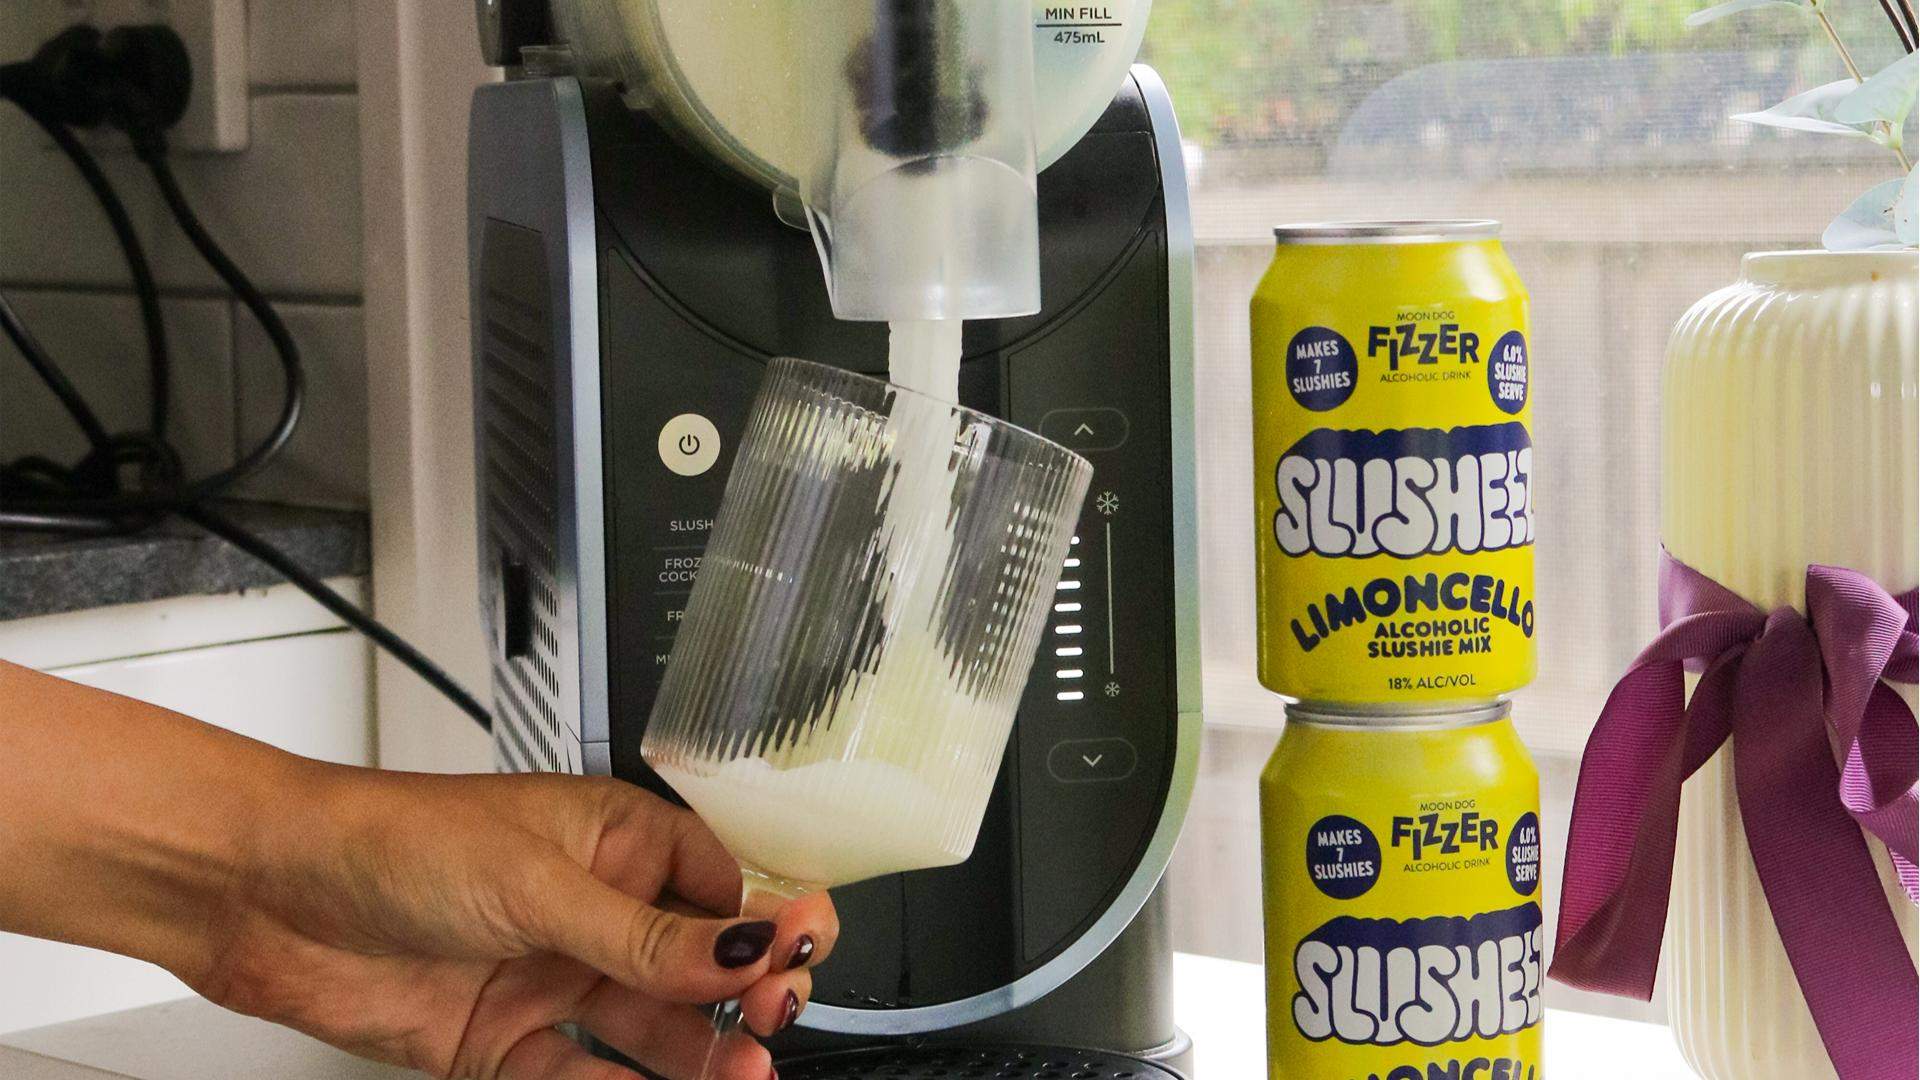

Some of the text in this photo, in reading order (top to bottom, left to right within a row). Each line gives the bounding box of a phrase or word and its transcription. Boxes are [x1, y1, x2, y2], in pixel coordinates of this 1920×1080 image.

[1045, 7, 1112, 20] MIN FILL
[1053, 31, 1105, 44] 475mL
[1397, 310, 1455, 321] MOON DOG
[1296, 340, 1339, 360] MAKES
[1368, 323, 1480, 371] FIZZER
[1503, 344, 1523, 363] 6.0%
[1314, 360, 1321, 374] 7
[1494, 362, 1526, 383] SLUSHIE
[1293, 372, 1351, 394] SLUSHIES
[1380, 370, 1471, 383] ALCOHOLIC DRINK
[1498, 382, 1524, 401] SERVE
[670, 519, 714, 532] SLUSH
[665, 557, 702, 569] FROZ
[659, 571, 698, 583] COCK
[1291, 572, 1534, 652] LIMONCELLO
[1374, 617, 1490, 639] ALCOHOLIC
[1367, 636, 1492, 658] SLUSHIE MIX
[1388, 674, 1477, 690] 18% ALC/VOL
[1420, 799, 1476, 811] MOON DOG
[1317, 829, 1362, 847] MAKES
[1391, 812, 1499, 860] FIZZER
[1519, 827, 1536, 844] 6.0%
[1336, 848, 1344, 862] 7
[1512, 846, 1539, 864] SLUSHIE
[1314, 860, 1374, 880] SLUSHIES
[1403, 858, 1490, 873] ALCOHOLIC DRINK
[1515, 863, 1537, 882] SERVE
